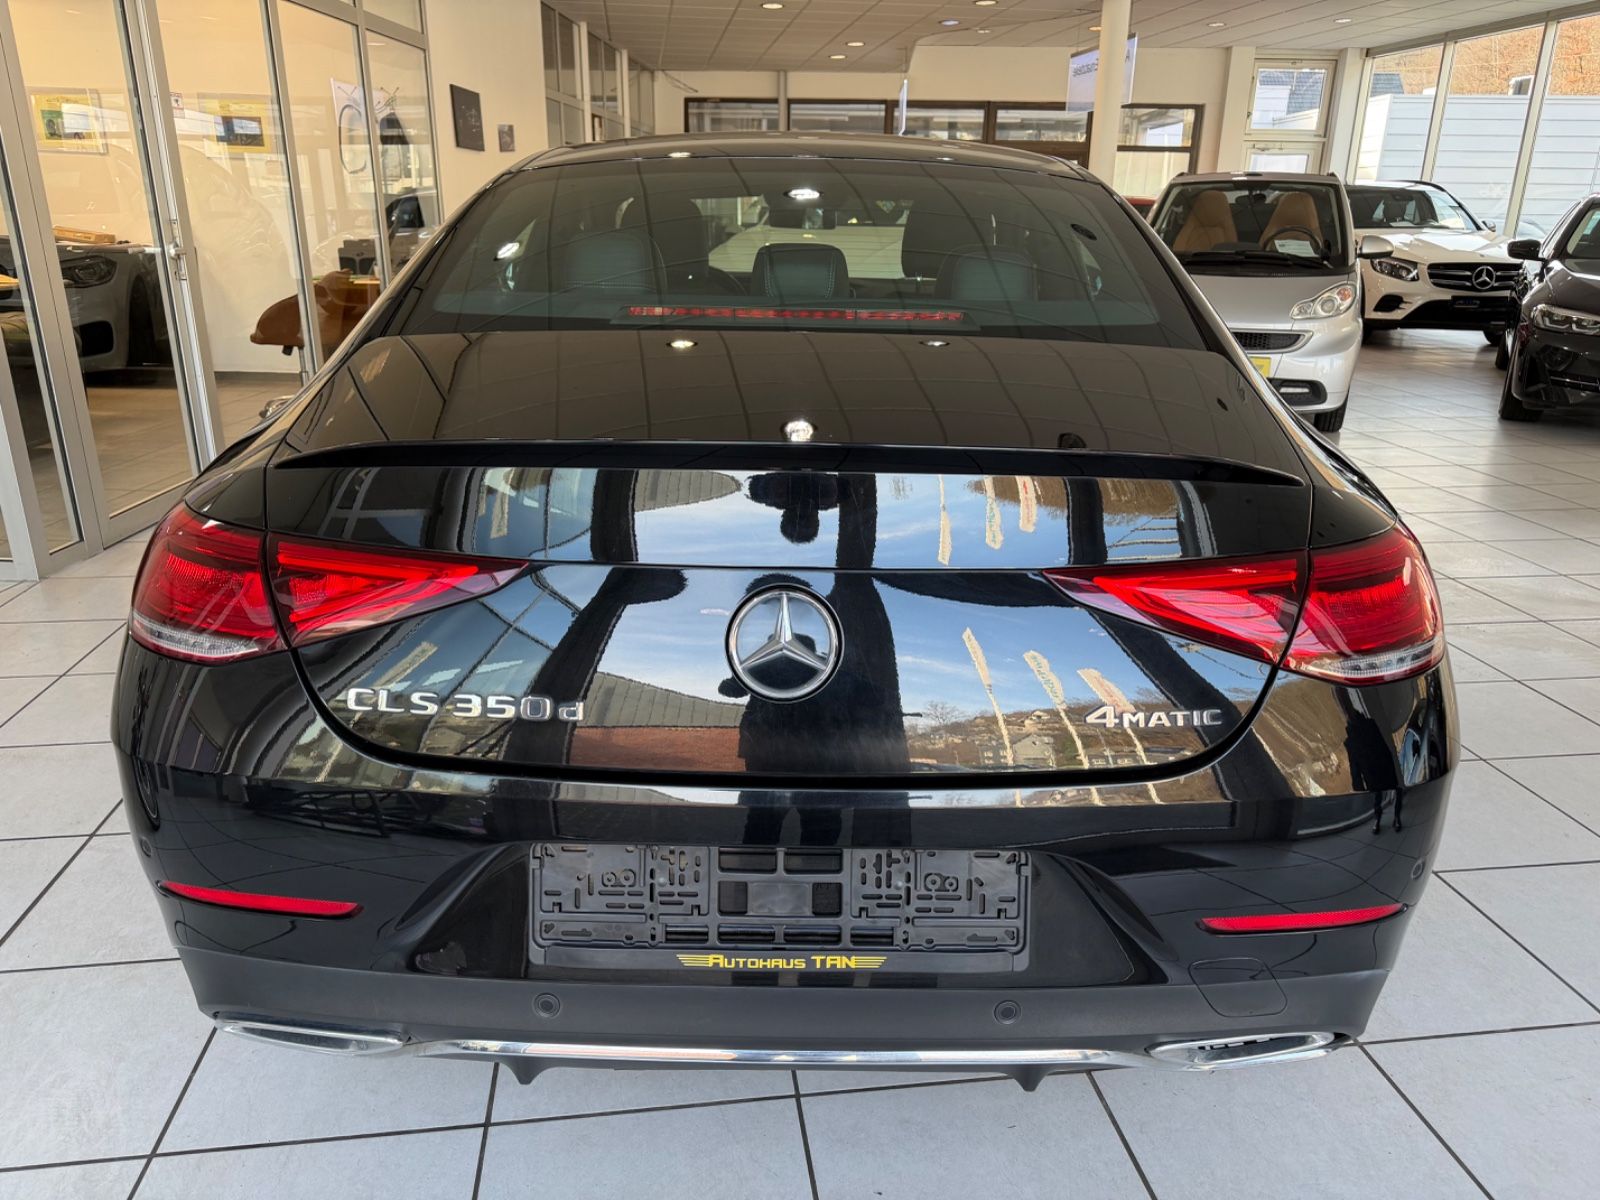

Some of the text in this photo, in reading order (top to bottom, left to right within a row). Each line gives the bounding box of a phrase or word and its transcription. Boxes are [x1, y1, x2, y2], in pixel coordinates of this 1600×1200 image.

[347, 688, 439, 715] CLS
[1085, 705, 1222, 728] 4MATIC
[811, 955, 856, 969] TAN
